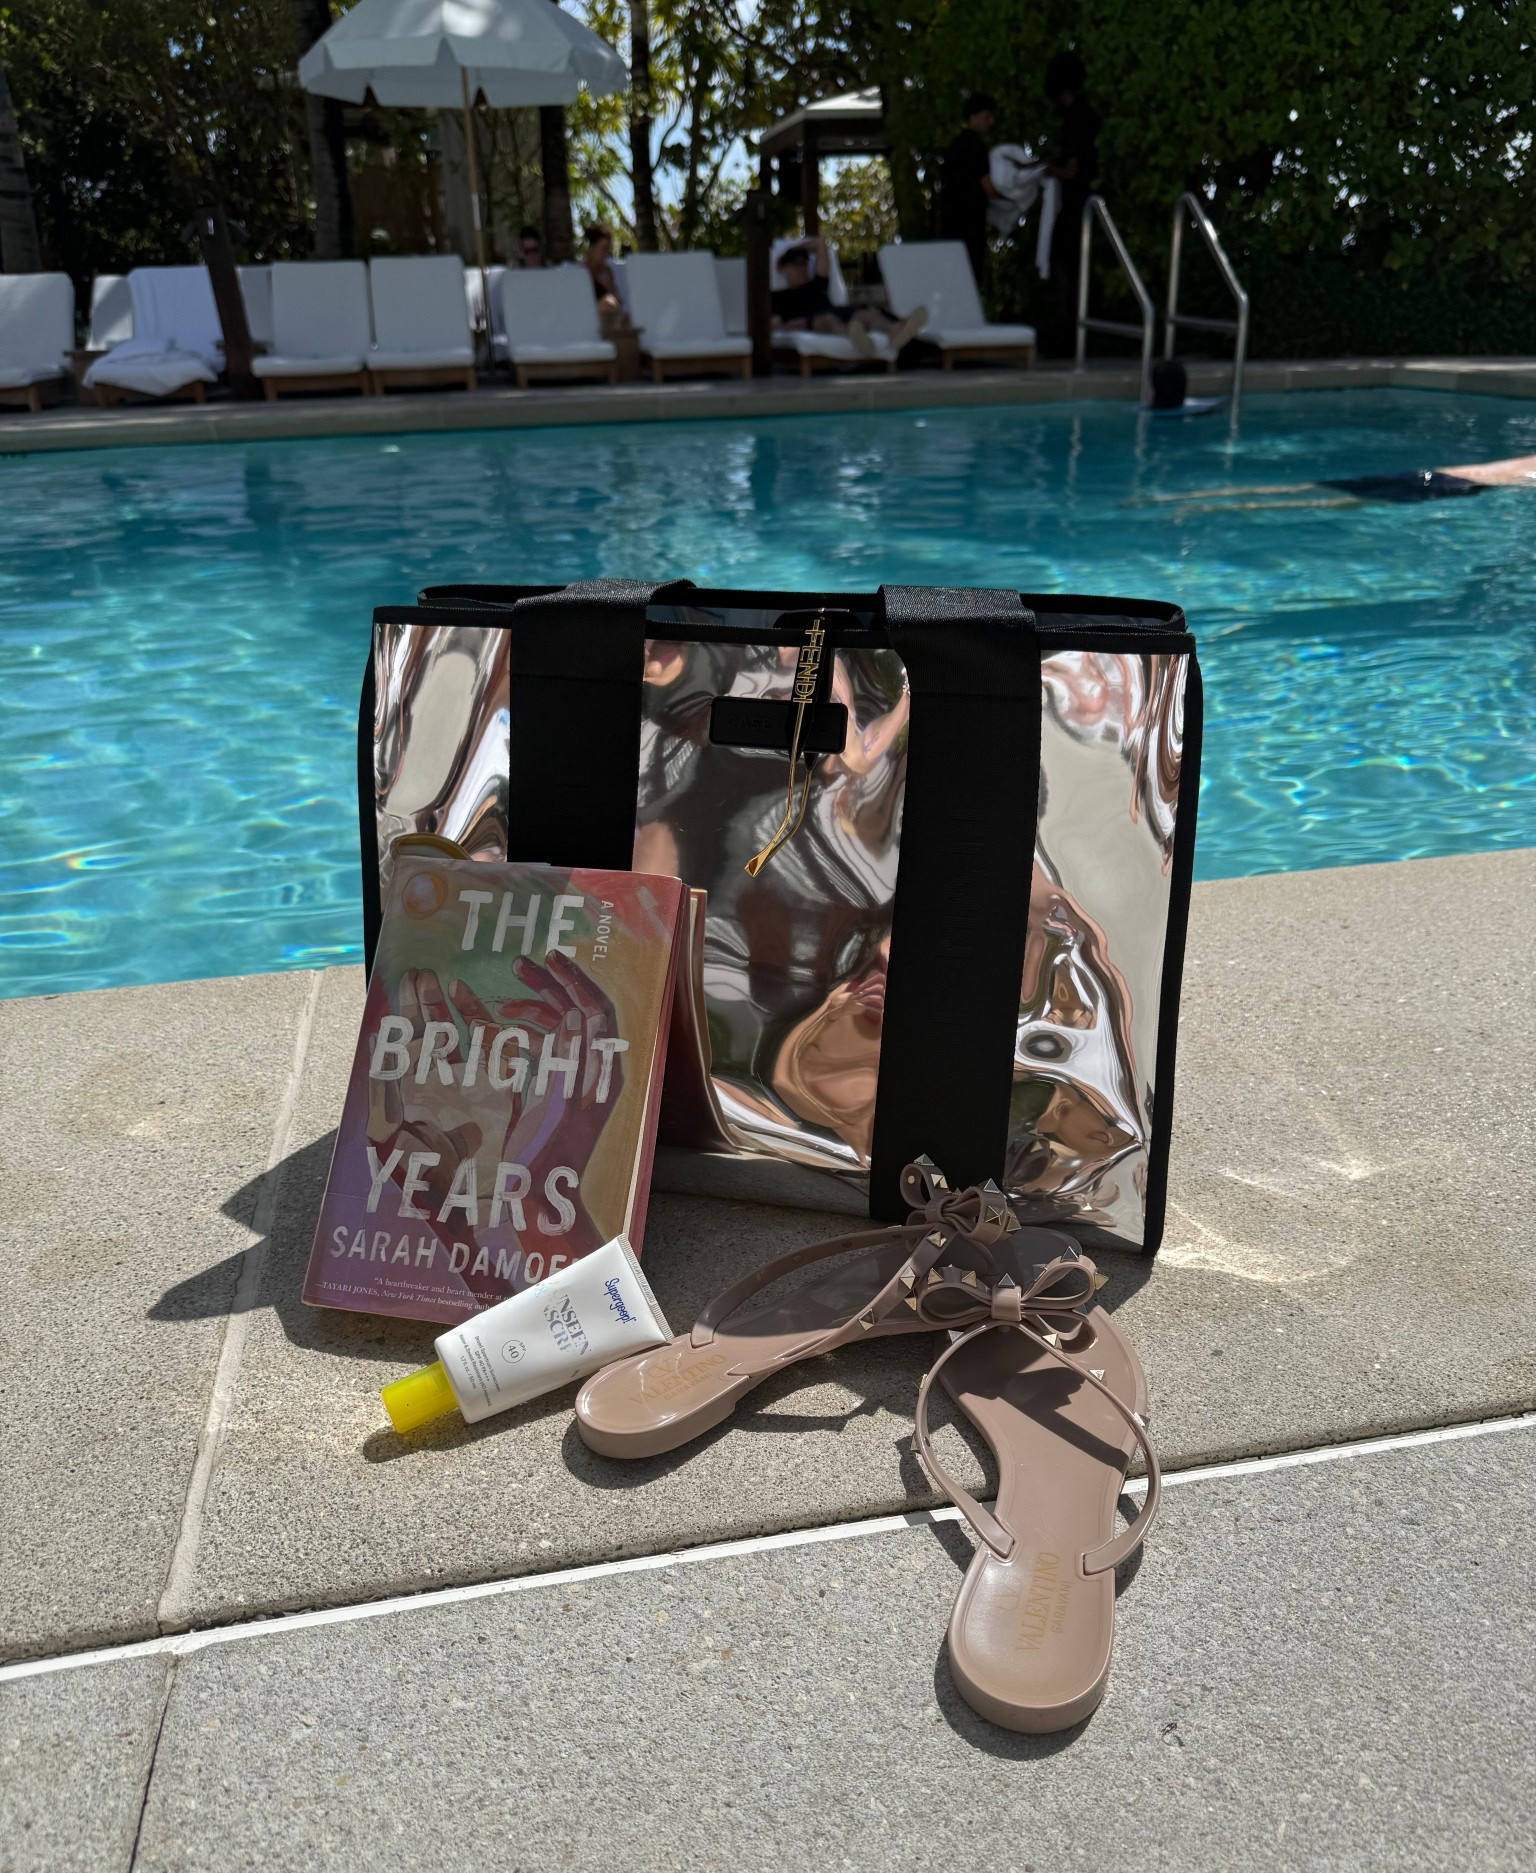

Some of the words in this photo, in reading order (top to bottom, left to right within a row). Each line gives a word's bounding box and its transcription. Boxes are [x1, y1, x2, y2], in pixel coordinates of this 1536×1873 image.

[793, 629, 825, 704] FENDI
[459, 889, 585, 958] THE
[601, 900, 614, 909] A
[592, 914, 612, 961] NOVEL
[368, 1015, 630, 1104] BRIGHT
[366, 1145, 580, 1237] YEARS
[329, 1225, 440, 1270] SARAH
[447, 1241, 581, 1284] DAMOF
[352, 1285, 380, 1297] JONES,
[381, 1289, 397, 1298] New
[397, 1291, 415, 1301] York
[416, 1294, 437, 1304] Times
[438, 1296, 473, 1311] bestselling
[385, 1278, 429, 1291] heartbreaker
[431, 1285, 445, 1294] and
[446, 1287, 465, 1297] heart
[467, 1290, 494, 1301] mender
[604, 1277, 634, 1324] Supergoop!
[508, 1344, 520, 1359] 40
[630, 1354, 726, 1404] VALENTINO
[1016, 1552, 1060, 1651] VALENTINO
[1053, 1580, 1073, 1634] GARAVANI
